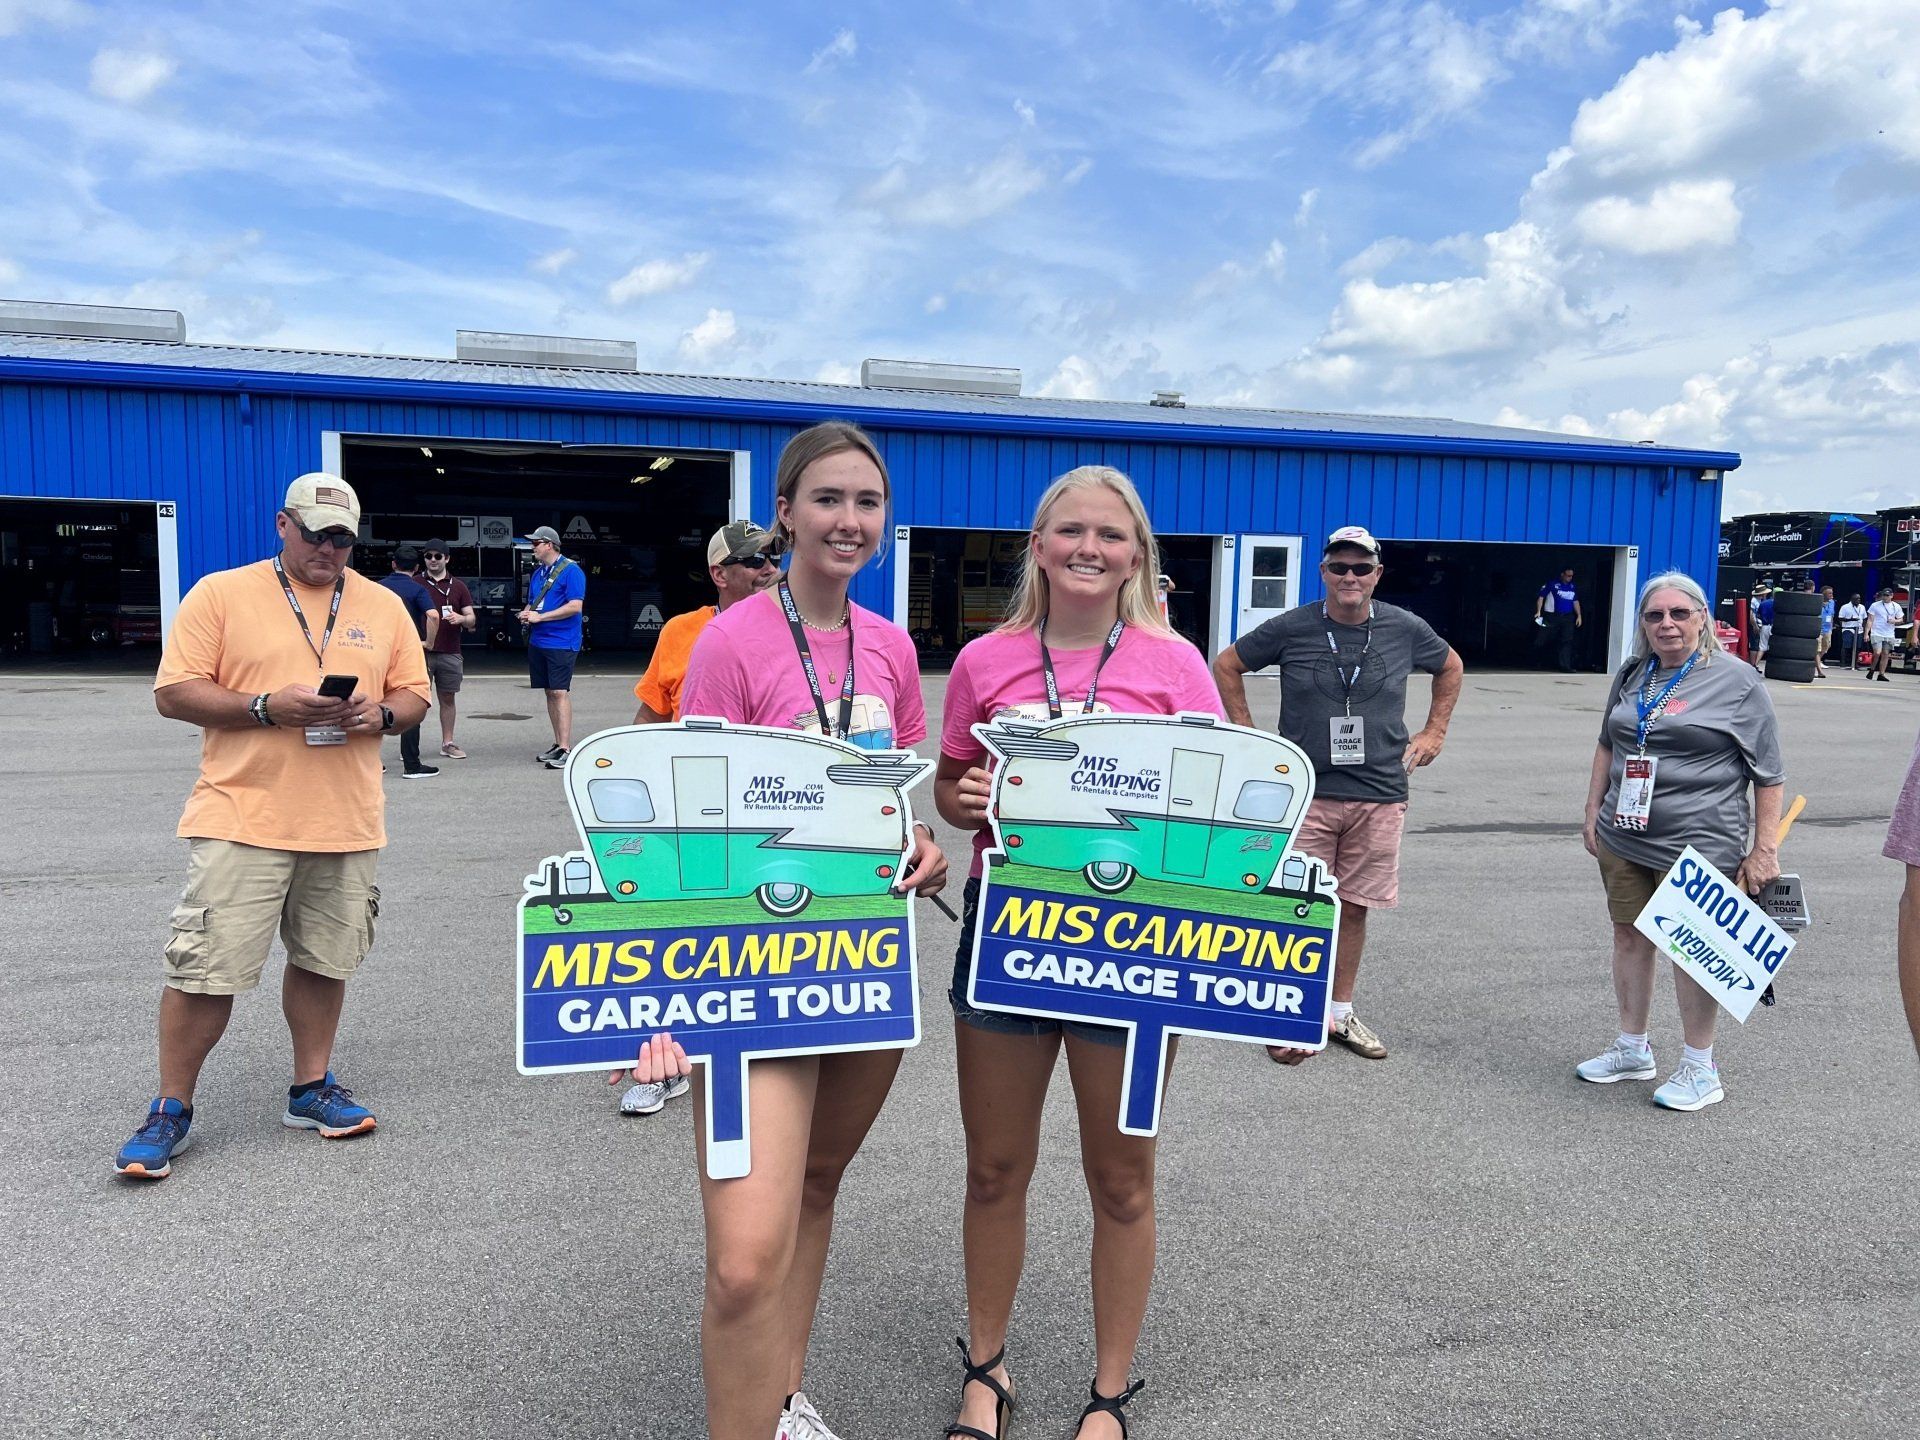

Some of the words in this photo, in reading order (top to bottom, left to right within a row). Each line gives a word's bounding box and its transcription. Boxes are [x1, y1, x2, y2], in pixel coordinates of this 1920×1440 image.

[159, 506, 174, 516] 43
[483, 527, 509, 536] BUSCH
[897, 531, 908, 539] 40
[1225, 539, 1234, 547] 39
[489, 584, 506, 599] 4
[780, 590, 799, 622] NASCAR
[337, 642, 374, 650] SALTWATER
[804, 662, 821, 697] NASCAR
[1045, 671, 1058, 702] NASCAR
[1078, 755, 1118, 772] MIS
[1138, 768, 1160, 777] .COM
[749, 776, 785, 790] MIS
[1071, 770, 1161, 792] CAMPING
[743, 790, 825, 804] CAMPING
[1083, 786, 1111, 796] Rentals
[1120, 790, 1159, 800] Campsites
[788, 804, 824, 812] Campsites
[1671, 858, 1750, 941] TOURS
[1768, 899, 1802, 907] GARAGE
[991, 896, 1101, 944] MIS
[1103, 911, 1325, 974] CAMPING
[1668, 924, 1744, 991] MICHIGAN
[1742, 924, 1789, 975] PIT
[532, 939, 656, 989] MIS
[662, 927, 900, 981] CAMPING
[1003, 948, 1179, 998] GARAGE
[1188, 971, 1304, 1015] TOUR
[557, 989, 757, 1034] GARAGE
[768, 981, 893, 1017] TOUR
